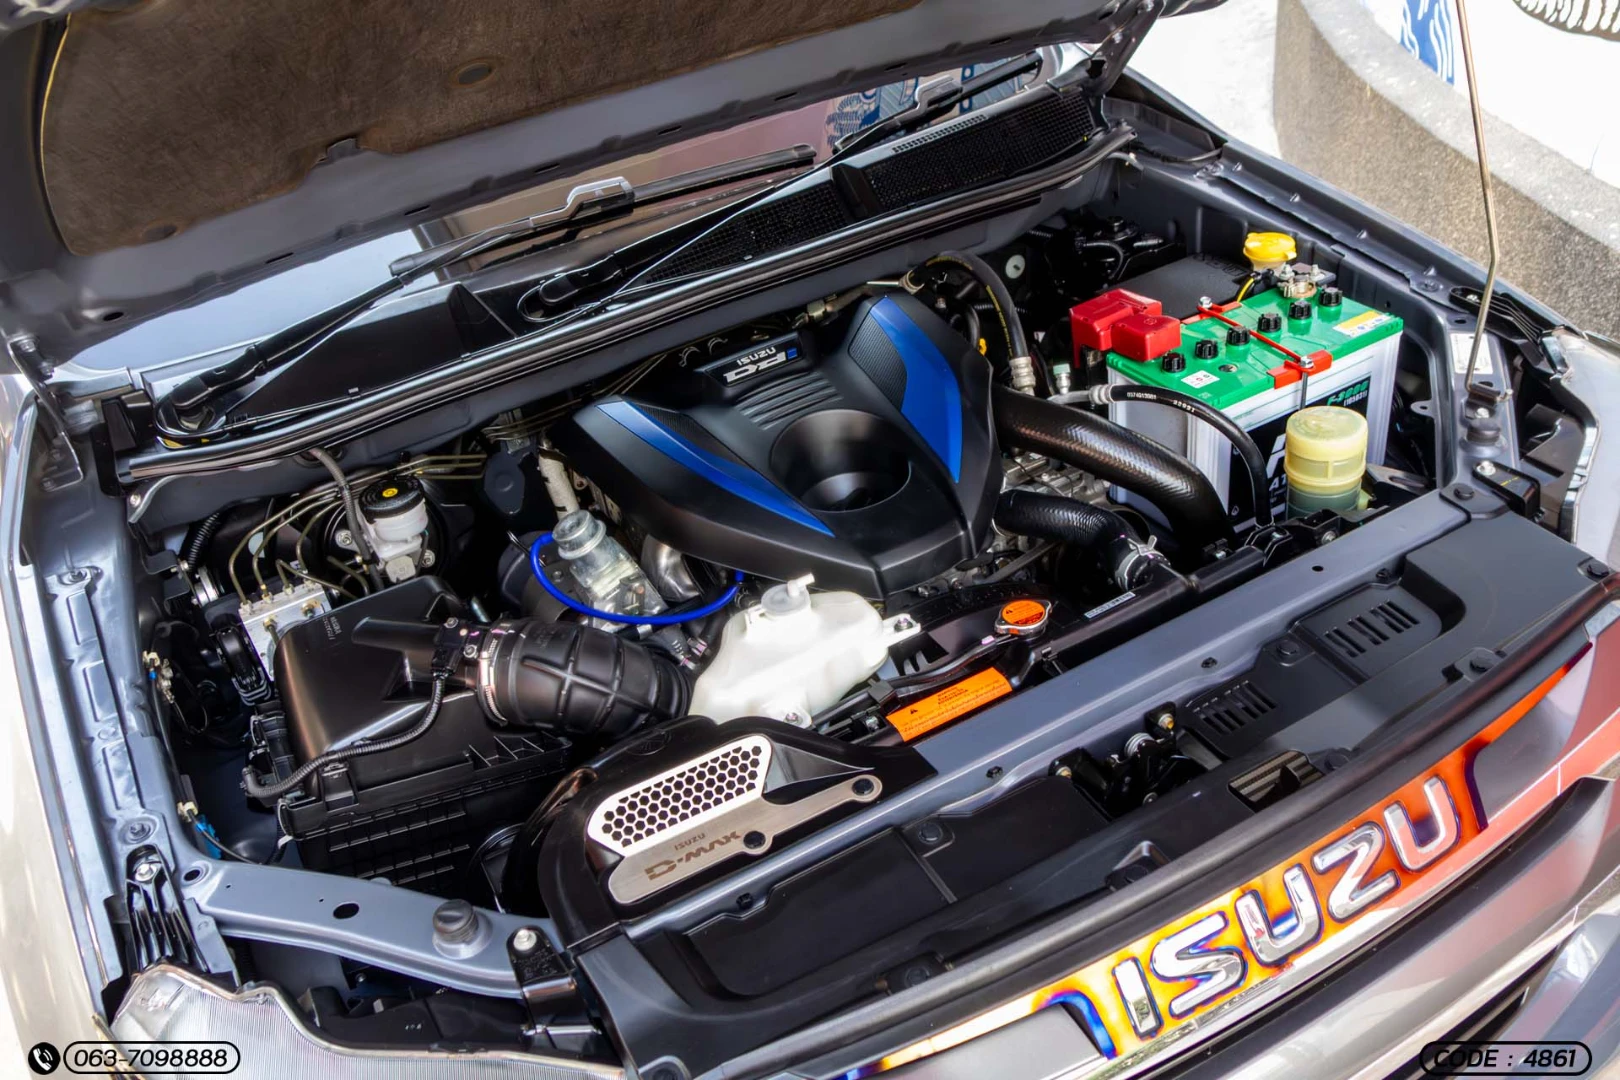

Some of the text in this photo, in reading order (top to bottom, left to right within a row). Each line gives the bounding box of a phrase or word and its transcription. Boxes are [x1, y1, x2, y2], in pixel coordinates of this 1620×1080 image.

[736, 346, 776, 366] ISUZU
[645, 830, 741, 881] D-MAX
[674, 832, 706, 851] ISUZU
[1112, 774, 1463, 1041] ISUZU
